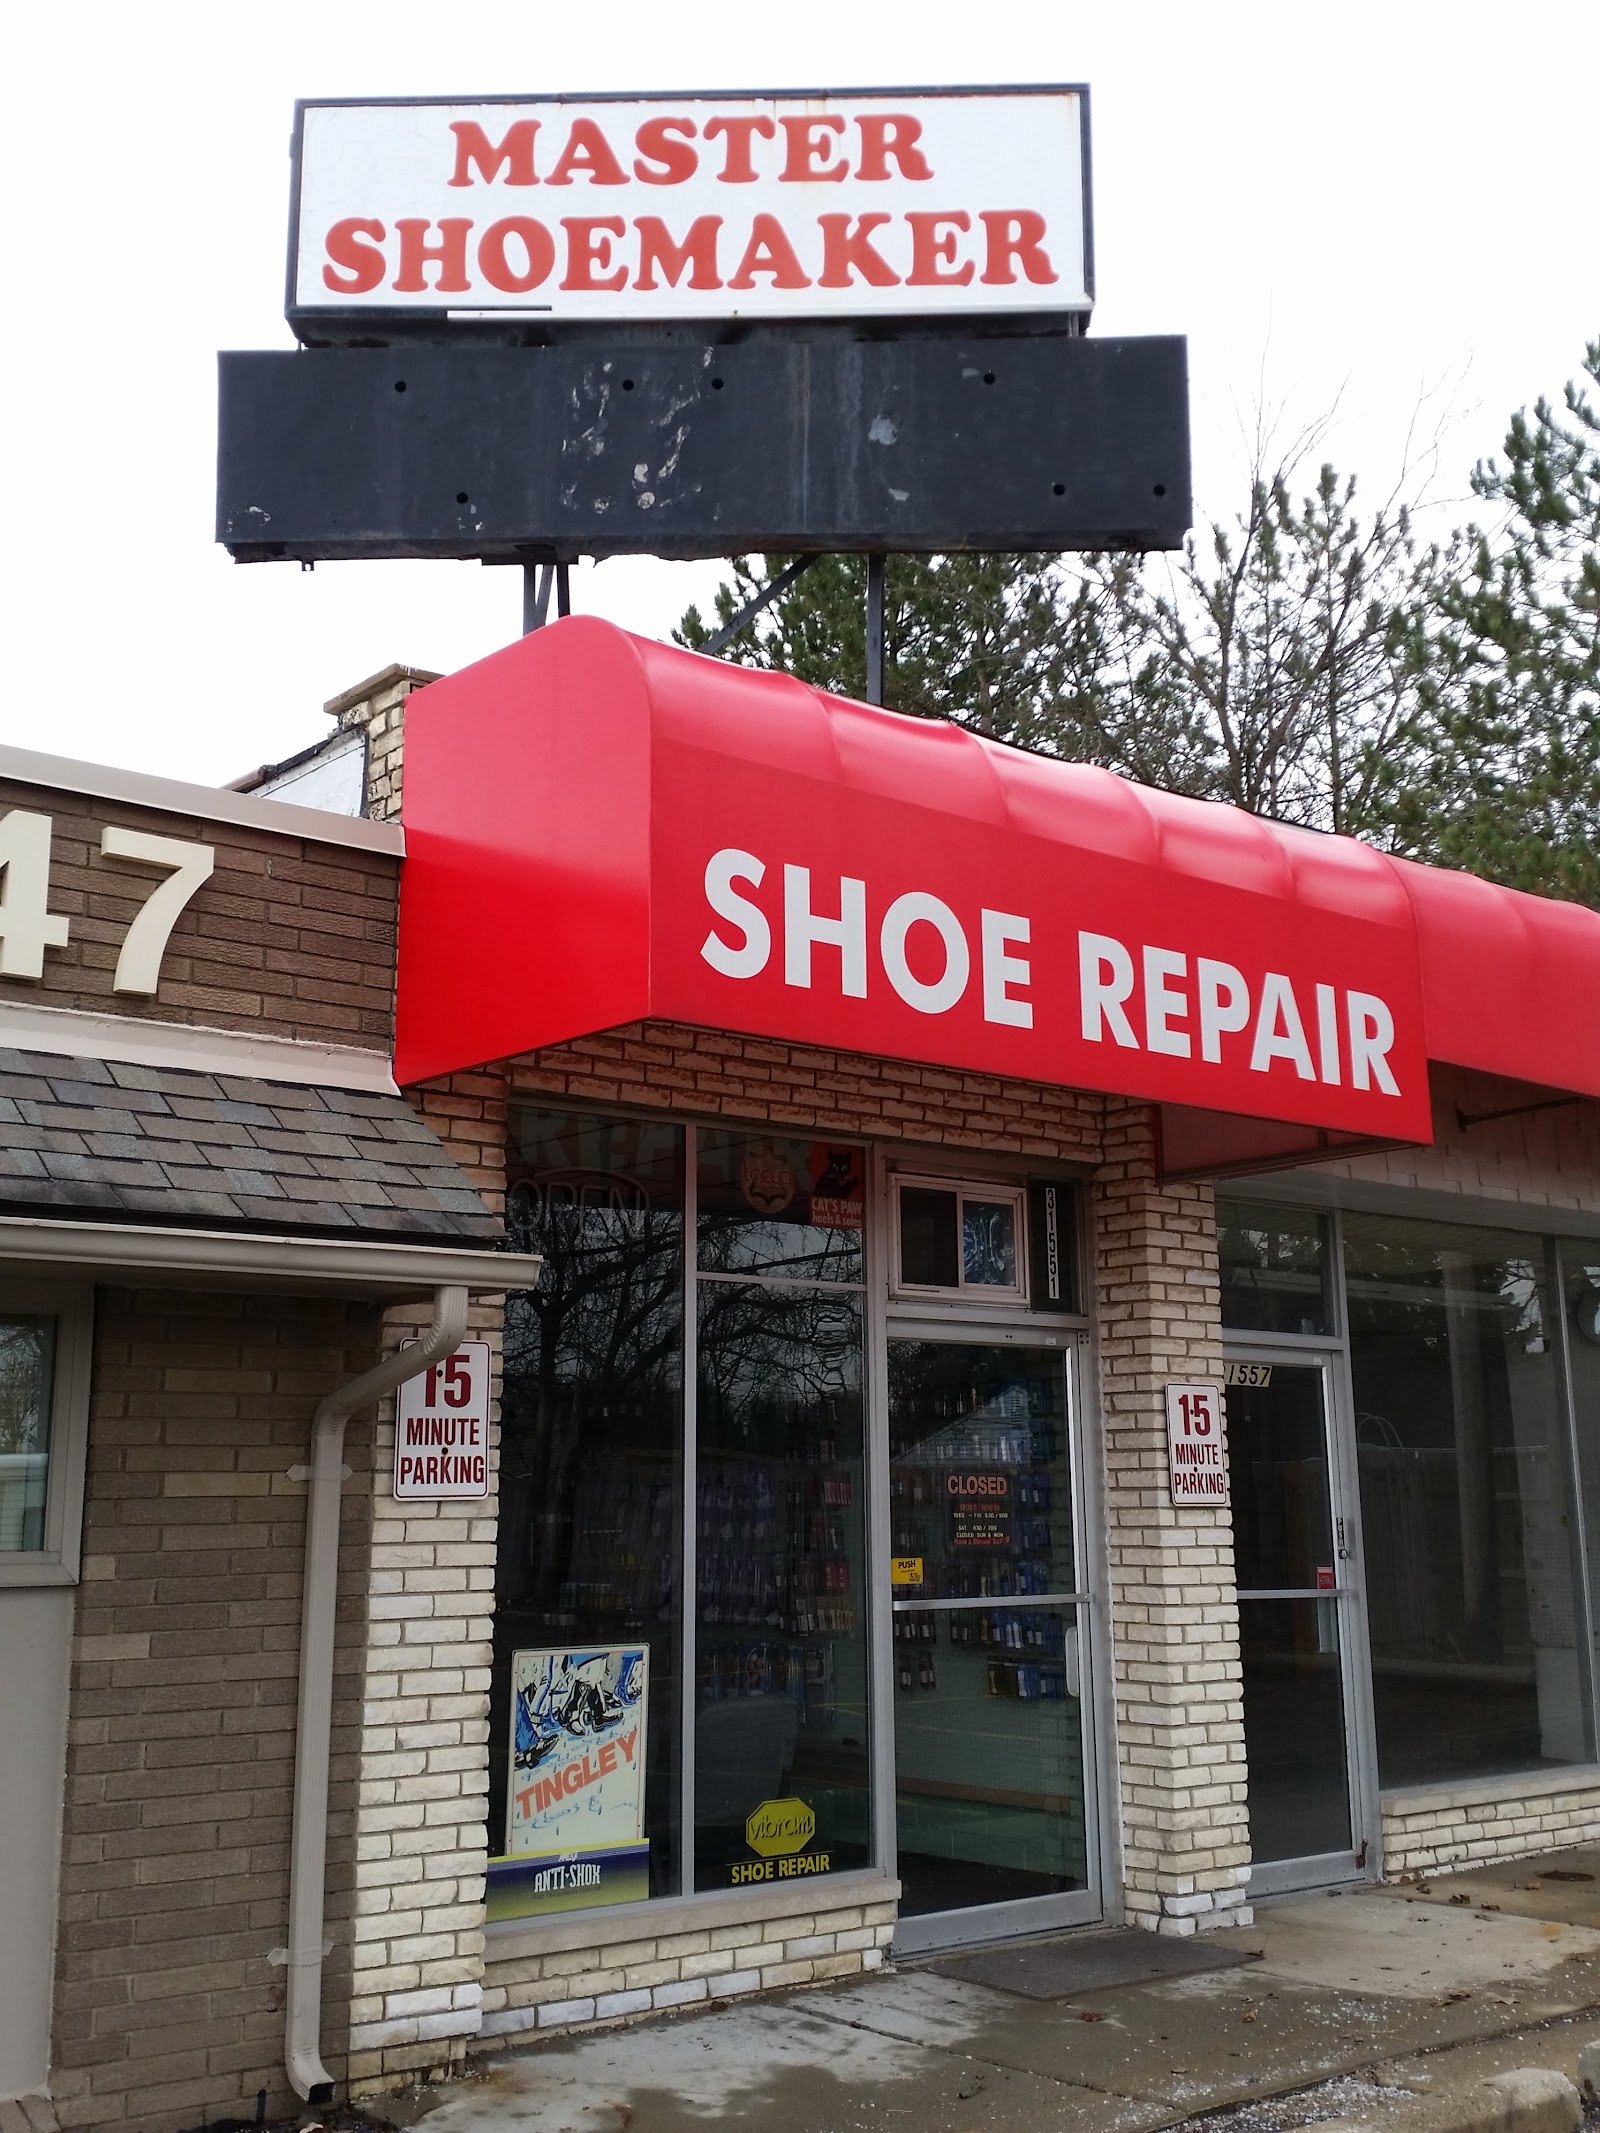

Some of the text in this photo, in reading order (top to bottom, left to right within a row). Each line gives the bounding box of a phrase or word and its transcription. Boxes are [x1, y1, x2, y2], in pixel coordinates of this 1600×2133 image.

[447, 113, 935, 187] MASTER
[322, 208, 1060, 293] SHOEMAKER
[701, 848, 1402, 1097] SHOE REPAIR
[508, 1178, 642, 1236] OPEN
[811, 1197, 862, 1215] CAT'S PAW
[812, 1211, 862, 1227] heels & soles
[1047, 1189, 1057, 1298] 31551
[425, 1354, 472, 1408] 15
[1224, 1363, 1270, 1386] 1557
[1178, 1394, 1211, 1436] 15
[406, 1418, 480, 1445] MINUTE
[1175, 1444, 1219, 1465] MINUTE
[400, 1456, 485, 1485] PARKING
[948, 1475, 1007, 1495] CLOSED
[1174, 1473, 1224, 1494] PARKING
[898, 1560, 916, 1569] PUSH
[516, 1729, 637, 1820] TINGLEY
[750, 1814, 813, 1840] vibram
[732, 1854, 831, 1884] SHOE REPAIR
